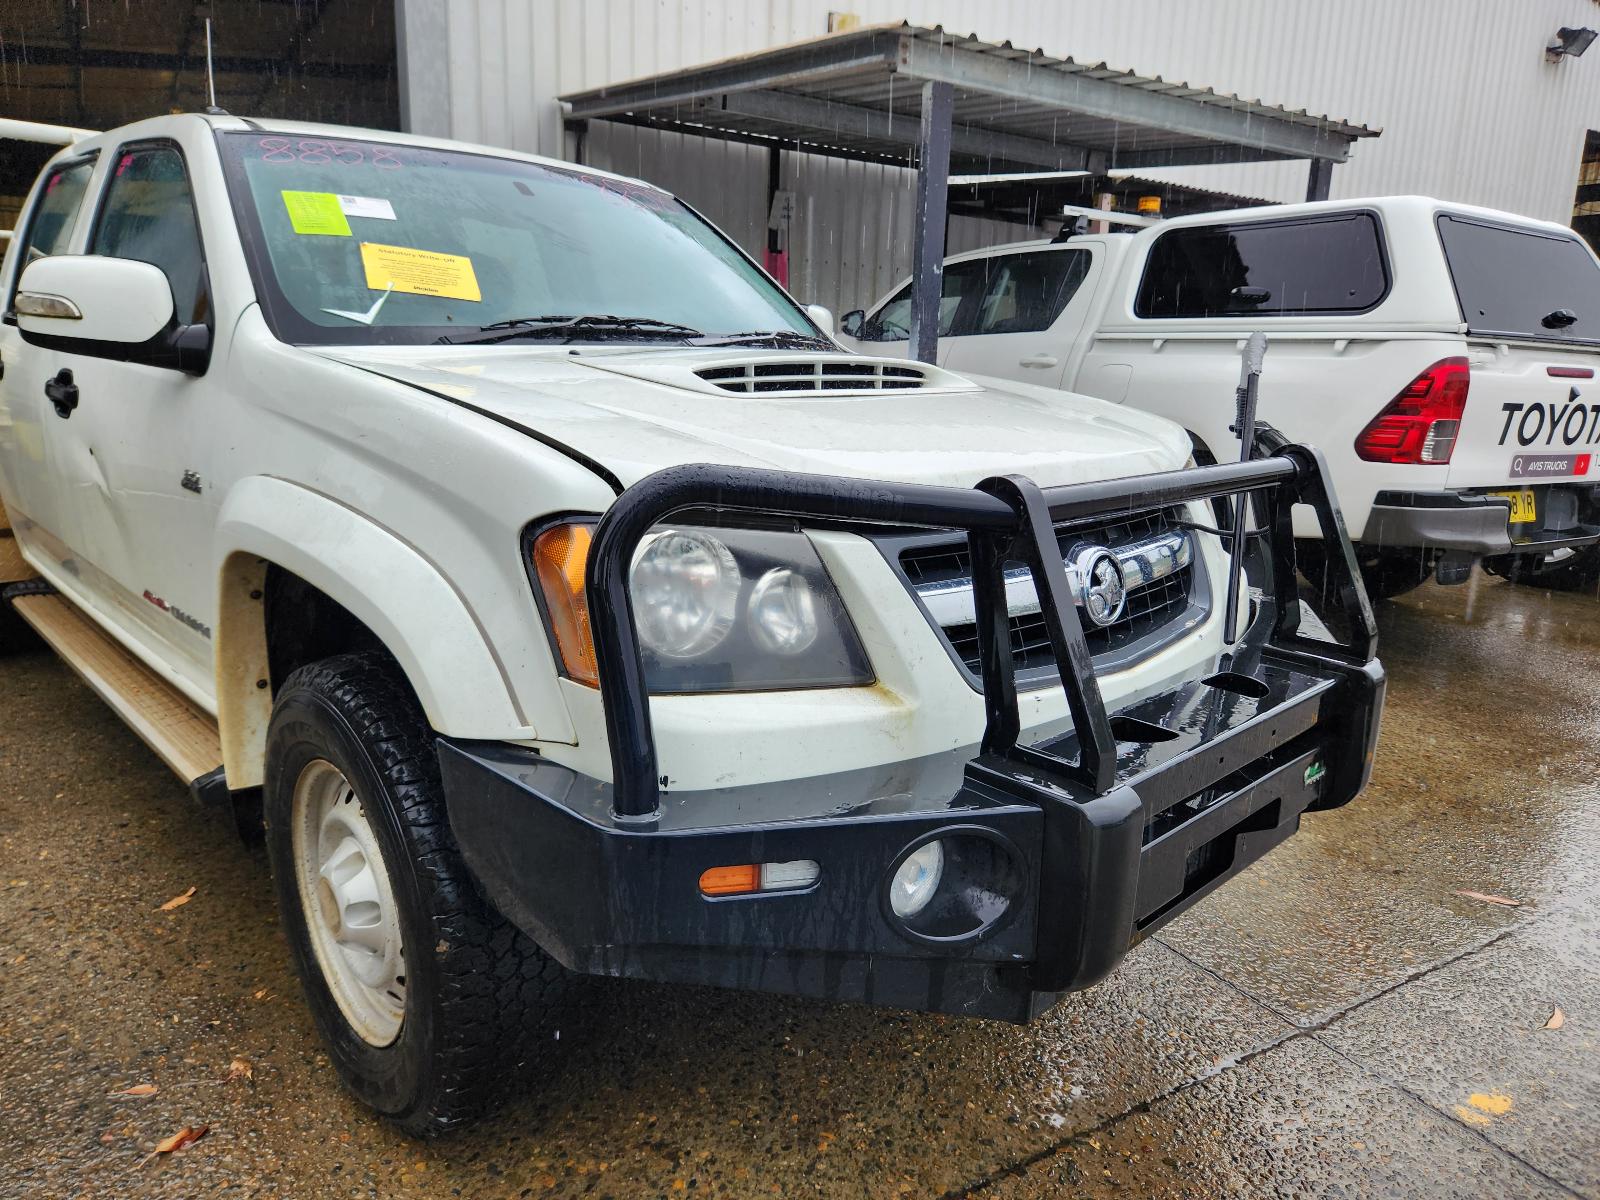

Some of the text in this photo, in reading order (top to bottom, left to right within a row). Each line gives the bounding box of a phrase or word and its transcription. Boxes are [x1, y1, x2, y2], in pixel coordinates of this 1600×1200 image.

[1498, 402, 1600, 446] TOYOT
[1527, 460, 1568, 471] AVIS TRUCKS
[1520, 494, 1534, 514] YR
